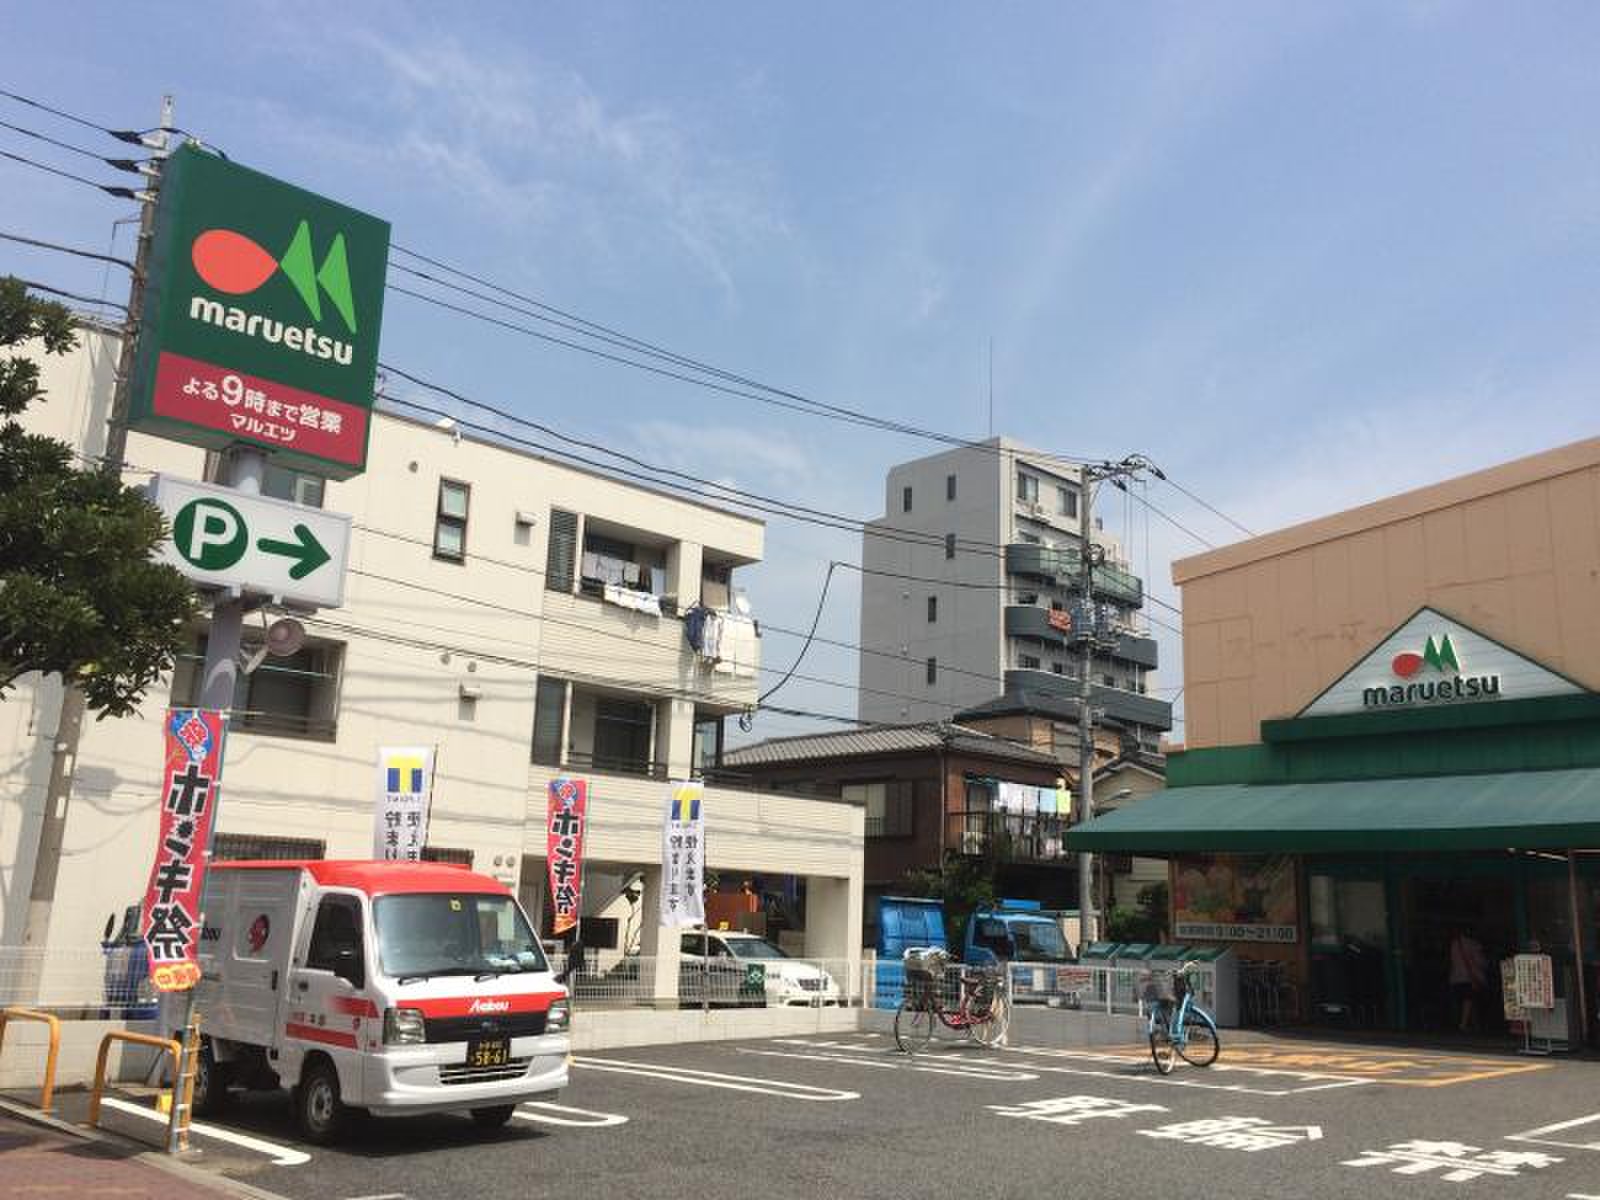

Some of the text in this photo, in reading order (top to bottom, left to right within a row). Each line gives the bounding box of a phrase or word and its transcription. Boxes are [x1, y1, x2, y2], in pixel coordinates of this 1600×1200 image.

[190, 296, 353, 366] maruetsu
[182, 374, 343, 435] よる9時まで営業
[229, 412, 297, 443] マルエツ
[188, 502, 239, 560] P
[1363, 674, 1500, 707] maruetsu
